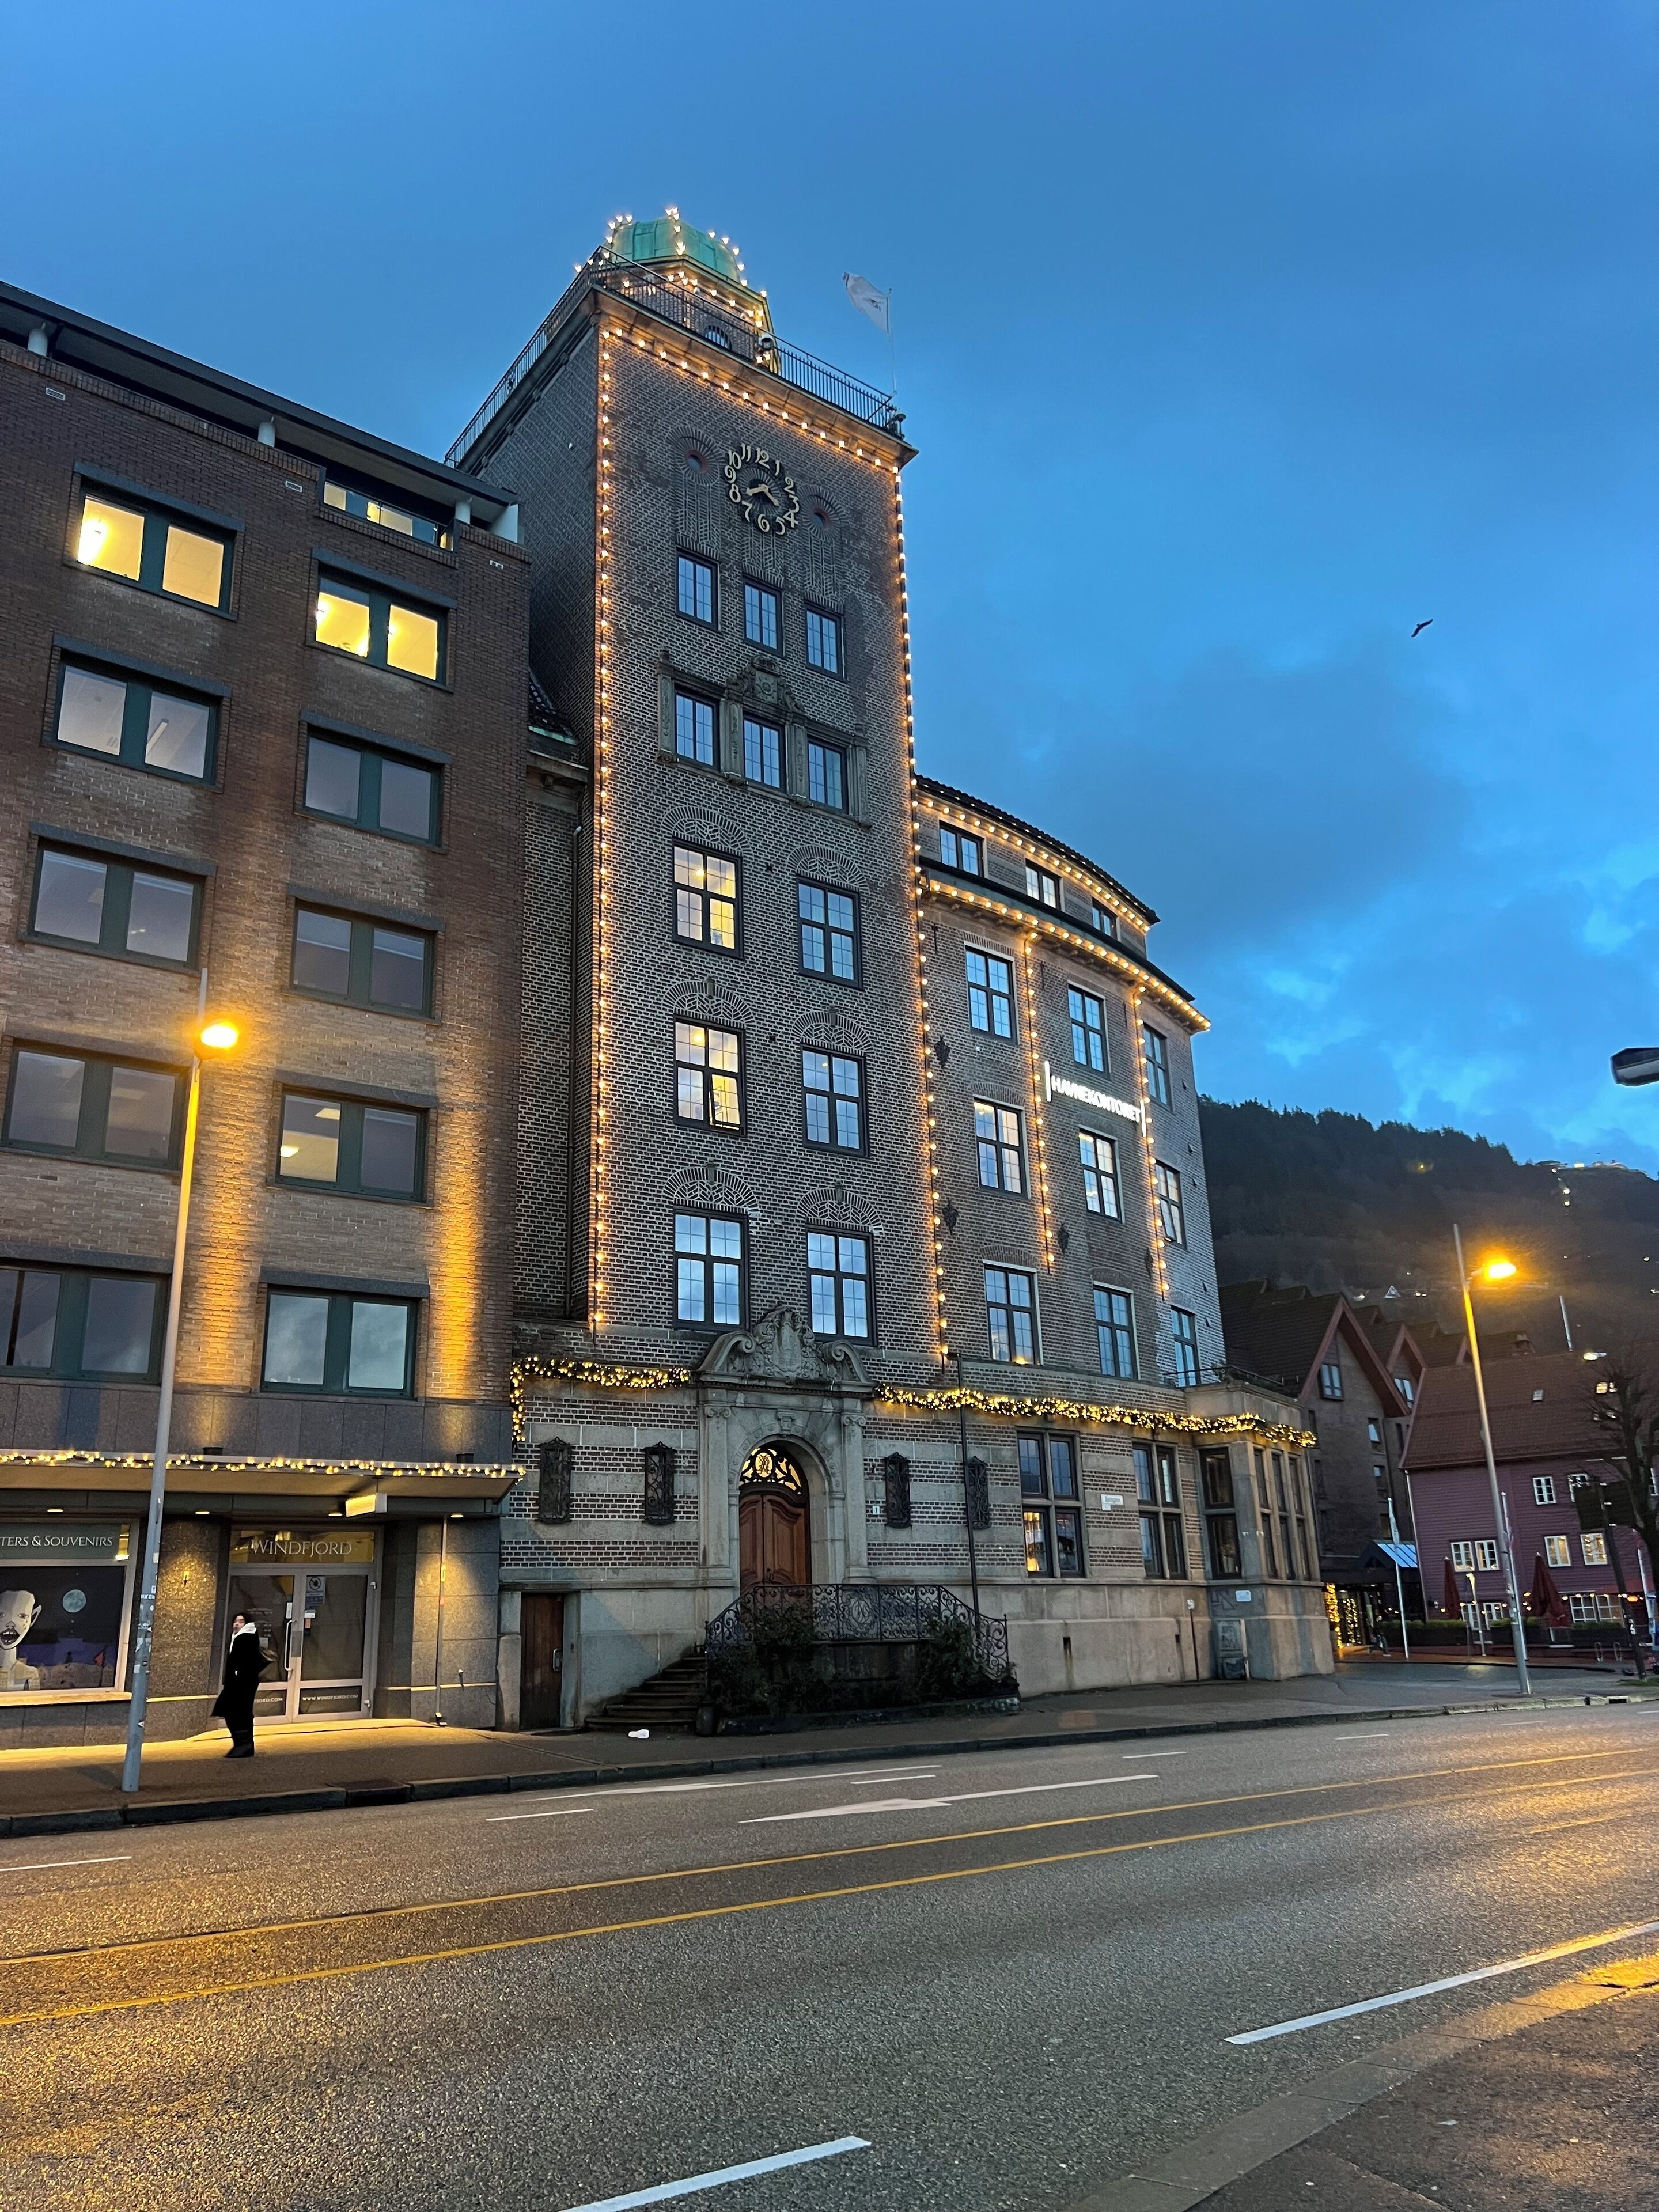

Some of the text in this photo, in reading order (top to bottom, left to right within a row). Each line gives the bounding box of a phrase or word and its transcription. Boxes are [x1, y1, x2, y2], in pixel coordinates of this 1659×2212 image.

[728, 450, 741, 469] 10
[741, 443, 751, 461] 11
[755, 448, 770, 469] 12
[724, 465, 736, 483] 9
[774, 460, 781, 476] 1
[729, 484, 741, 503] 8
[784, 476, 795, 494] 2
[741, 500, 753, 522] 7
[789, 494, 800, 513] 3
[757, 514, 770, 533] 6
[775, 517, 786, 535] 5
[783, 510, 799, 528] 4
[1051, 1075, 1141, 1123] HAVNEKONTORET
[32, 1535, 41, 1546] &
[251, 1539, 352, 1558] WINDFJORD
